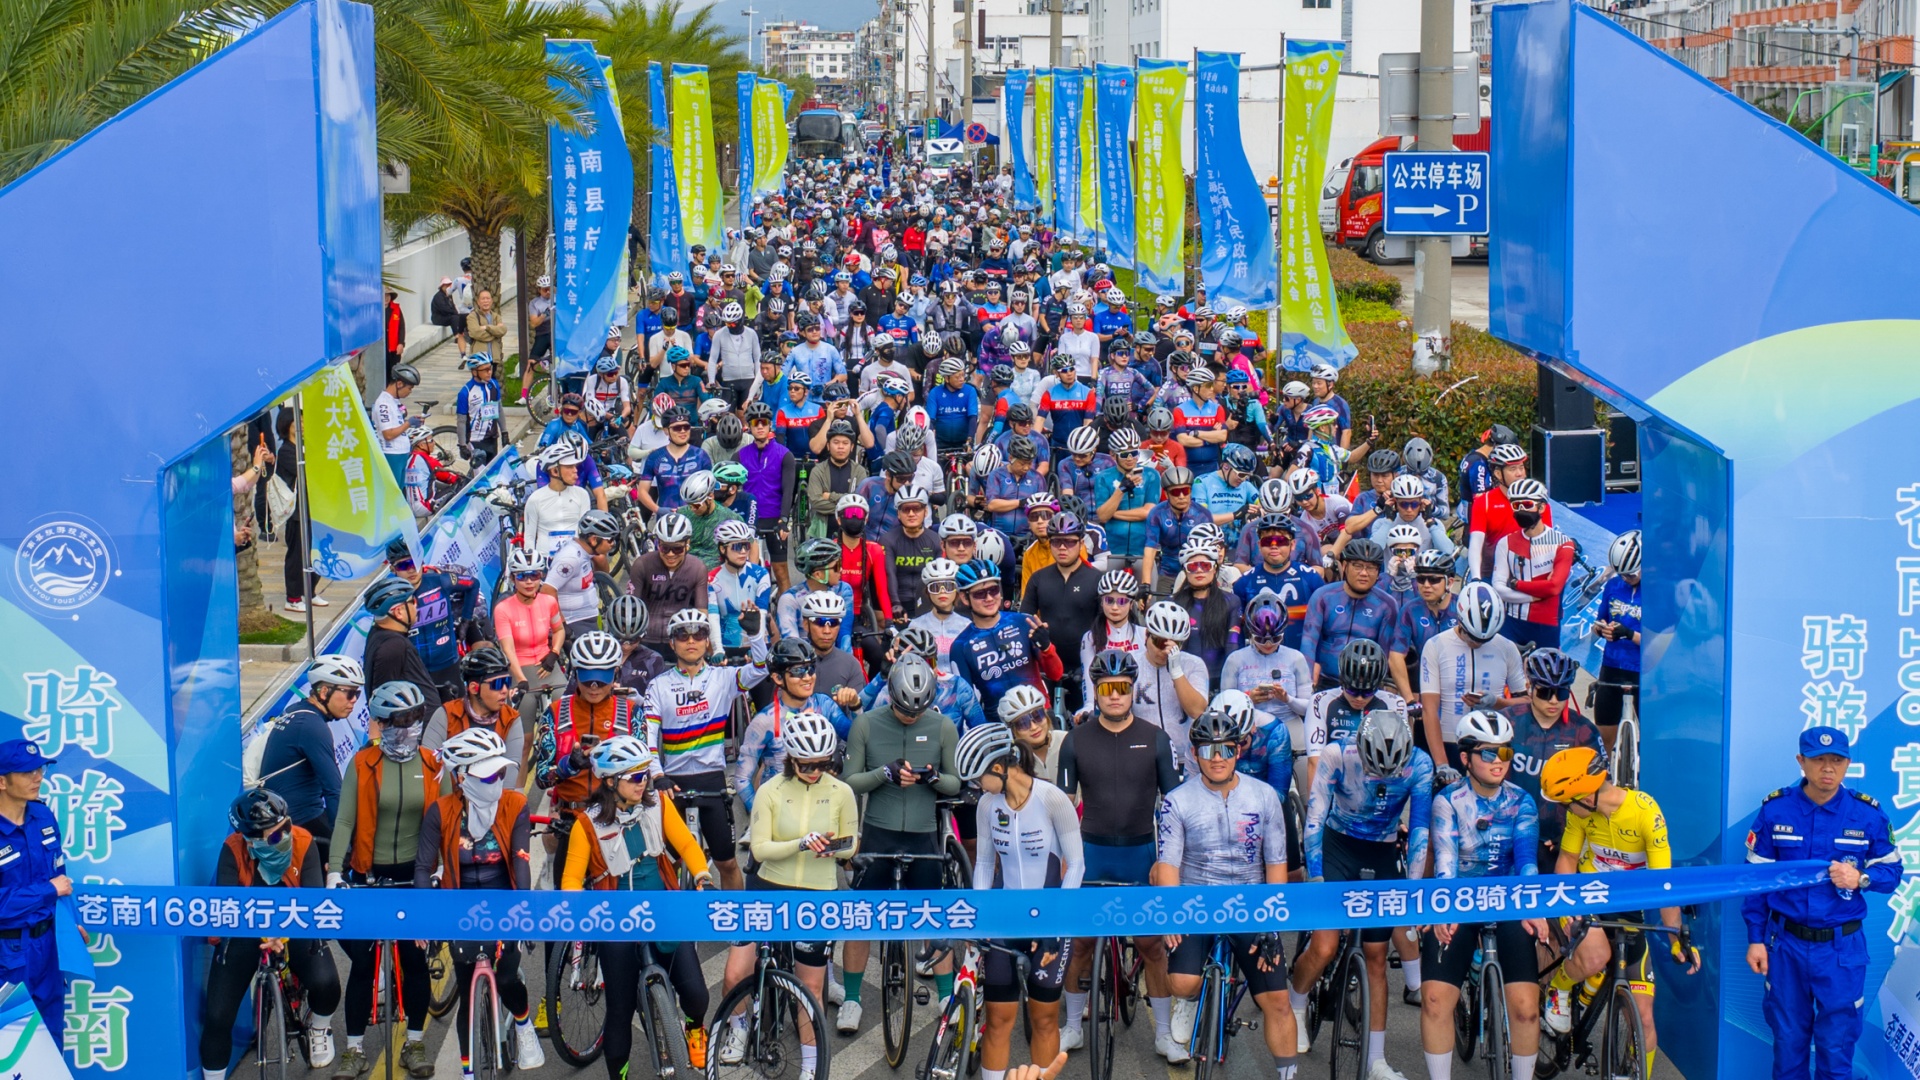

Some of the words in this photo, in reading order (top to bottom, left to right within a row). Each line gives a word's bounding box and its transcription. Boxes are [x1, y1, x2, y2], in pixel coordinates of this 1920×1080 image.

[1392, 161, 1482, 190] 公共停车场
[1456, 194, 1479, 225] P
[29, 583, 50, 601] LVYOU
[77, 581, 99, 600] JITUAN
[1002, 656, 1029, 673] suez
[677, 702, 709, 716] Emirates
[1454, 702, 1464, 715] NO
[1339, 719, 1355, 727] UBS
[1512, 752, 1547, 776] SU
[1618, 828, 1641, 838] LCL
[1602, 847, 1631, 862] UAE
[23, 665, 133, 1072] 骑游南
[1342, 880, 1610, 918] 苍南168骑行大会
[77, 894, 344, 930] 苍南168骑行大会
[708, 898, 978, 931] 苍南168骑行大会
[1055, 938, 1072, 984] DESCENTE
